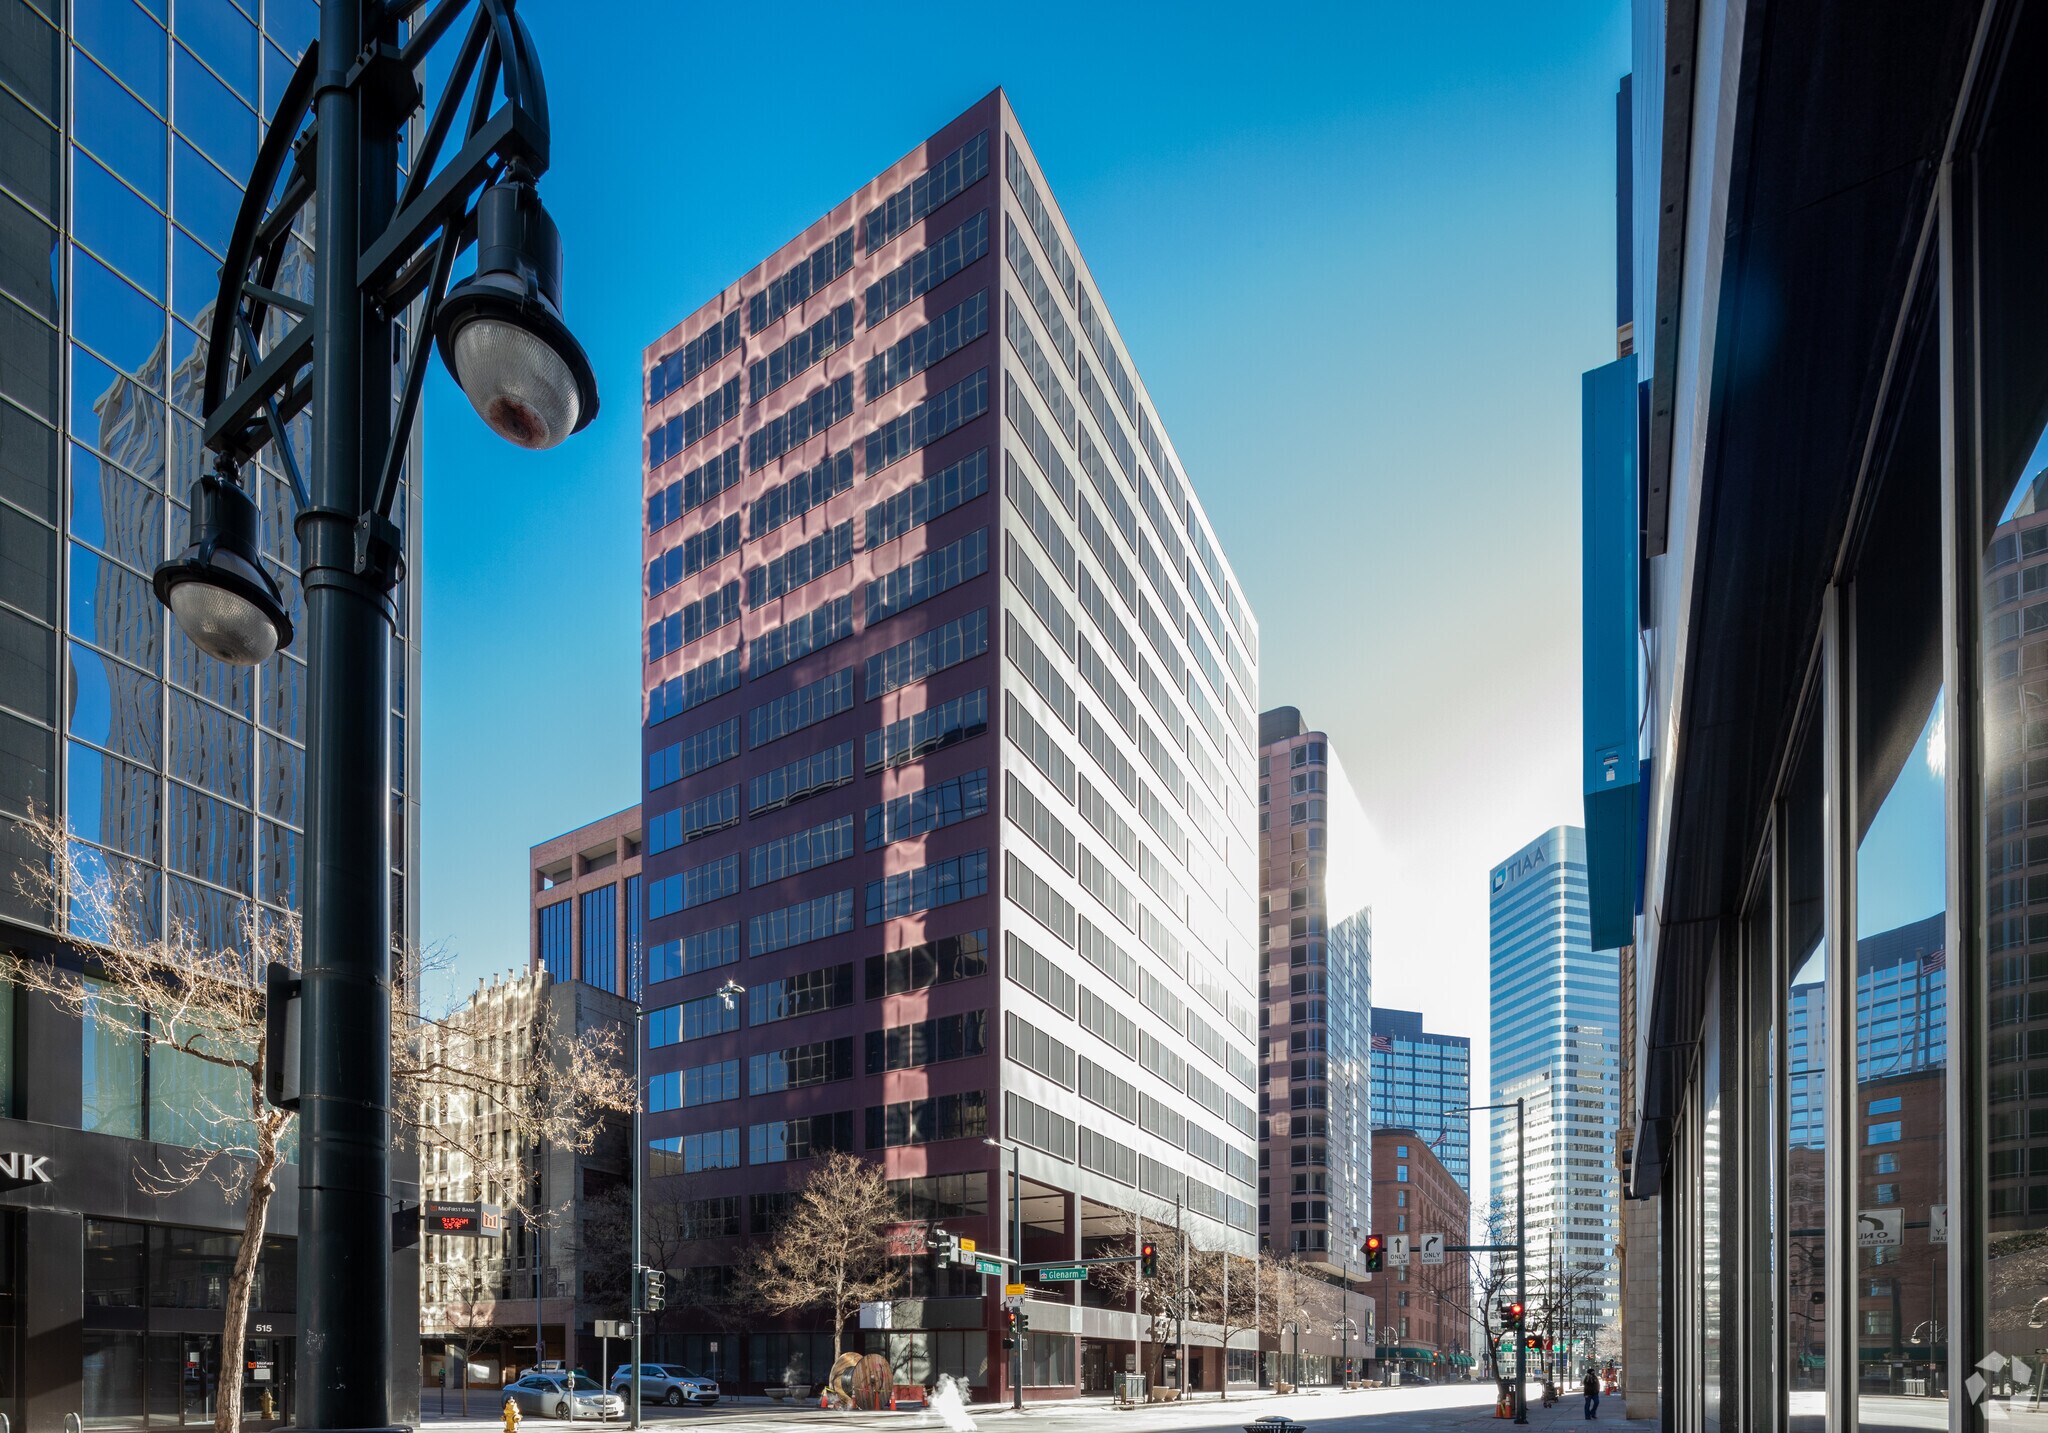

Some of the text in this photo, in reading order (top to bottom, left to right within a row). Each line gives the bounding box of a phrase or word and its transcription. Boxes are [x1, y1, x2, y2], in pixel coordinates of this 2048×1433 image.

[1506, 846, 1545, 881] TIAA
[0, 1152, 52, 1182] NK
[1048, 1271, 1079, 1279] Glenarm
[255, 1324, 272, 1332] 515
